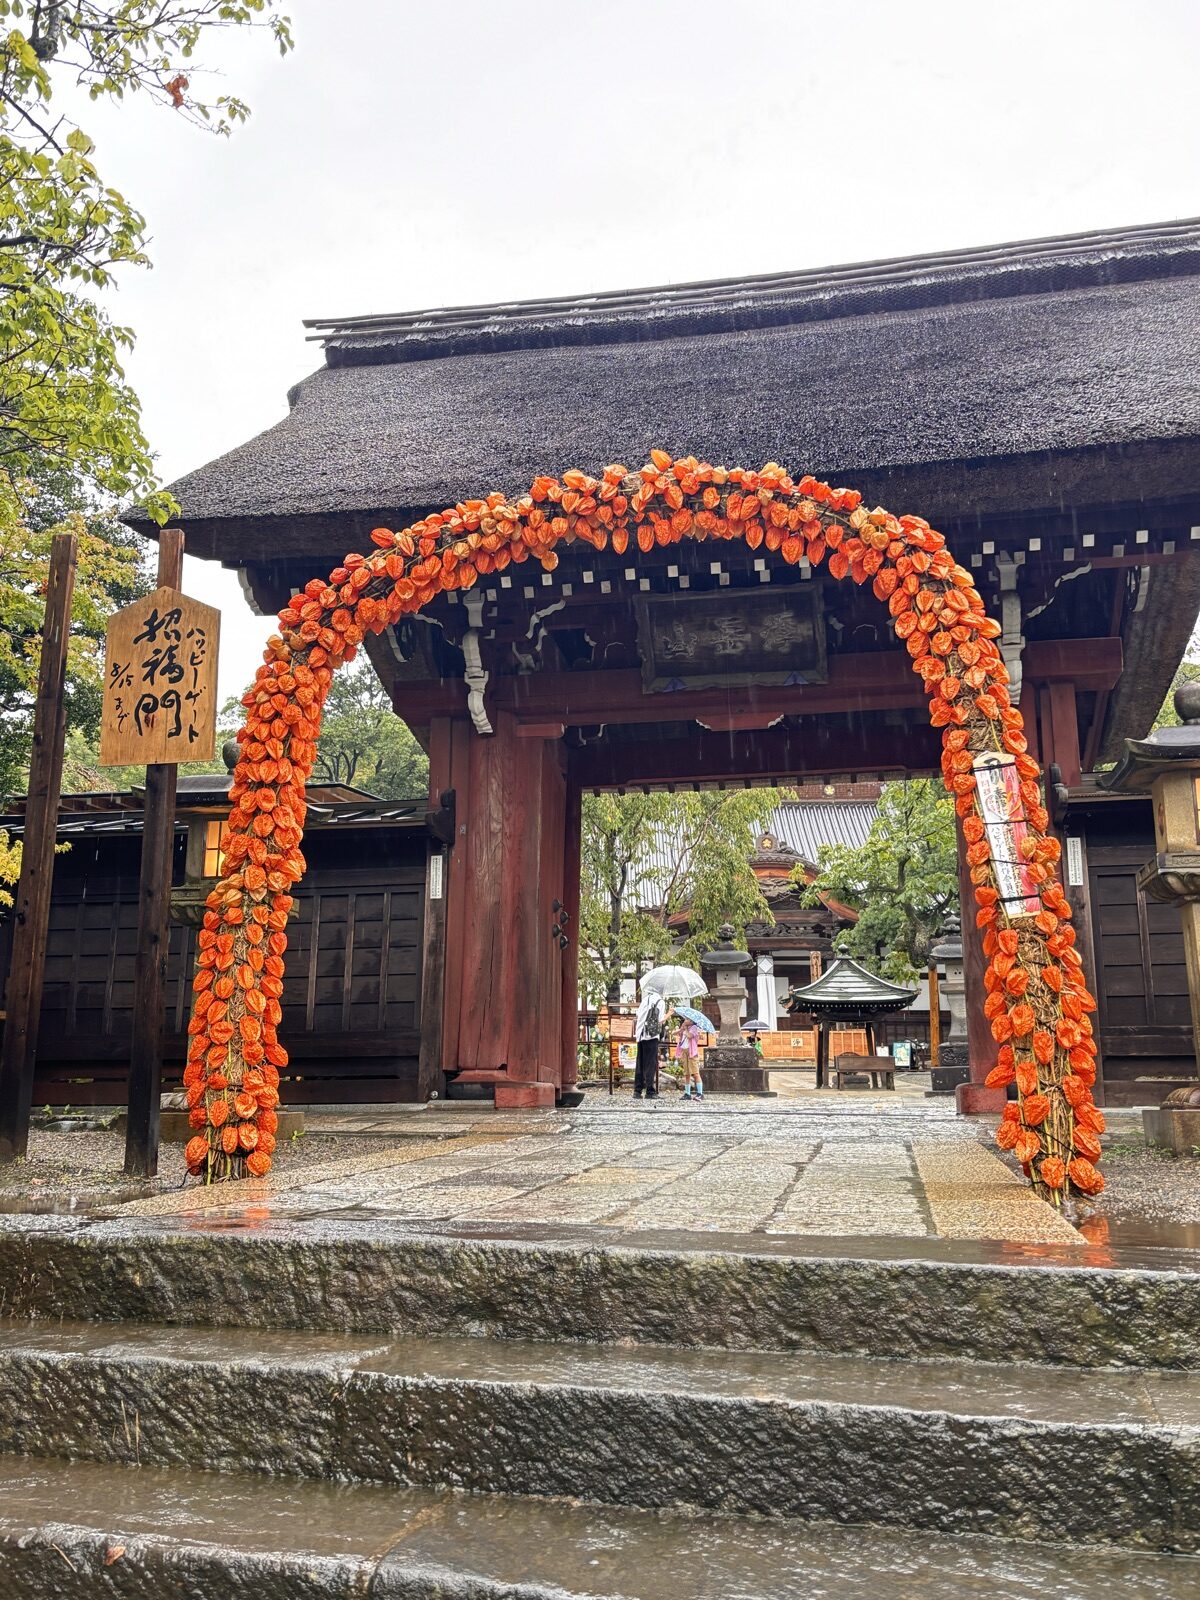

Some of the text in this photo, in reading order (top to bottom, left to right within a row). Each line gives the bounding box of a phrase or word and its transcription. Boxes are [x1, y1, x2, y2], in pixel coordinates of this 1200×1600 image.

[132, 607, 185, 739] 招福門
[185, 627, 207, 744] ハッピーゲート
